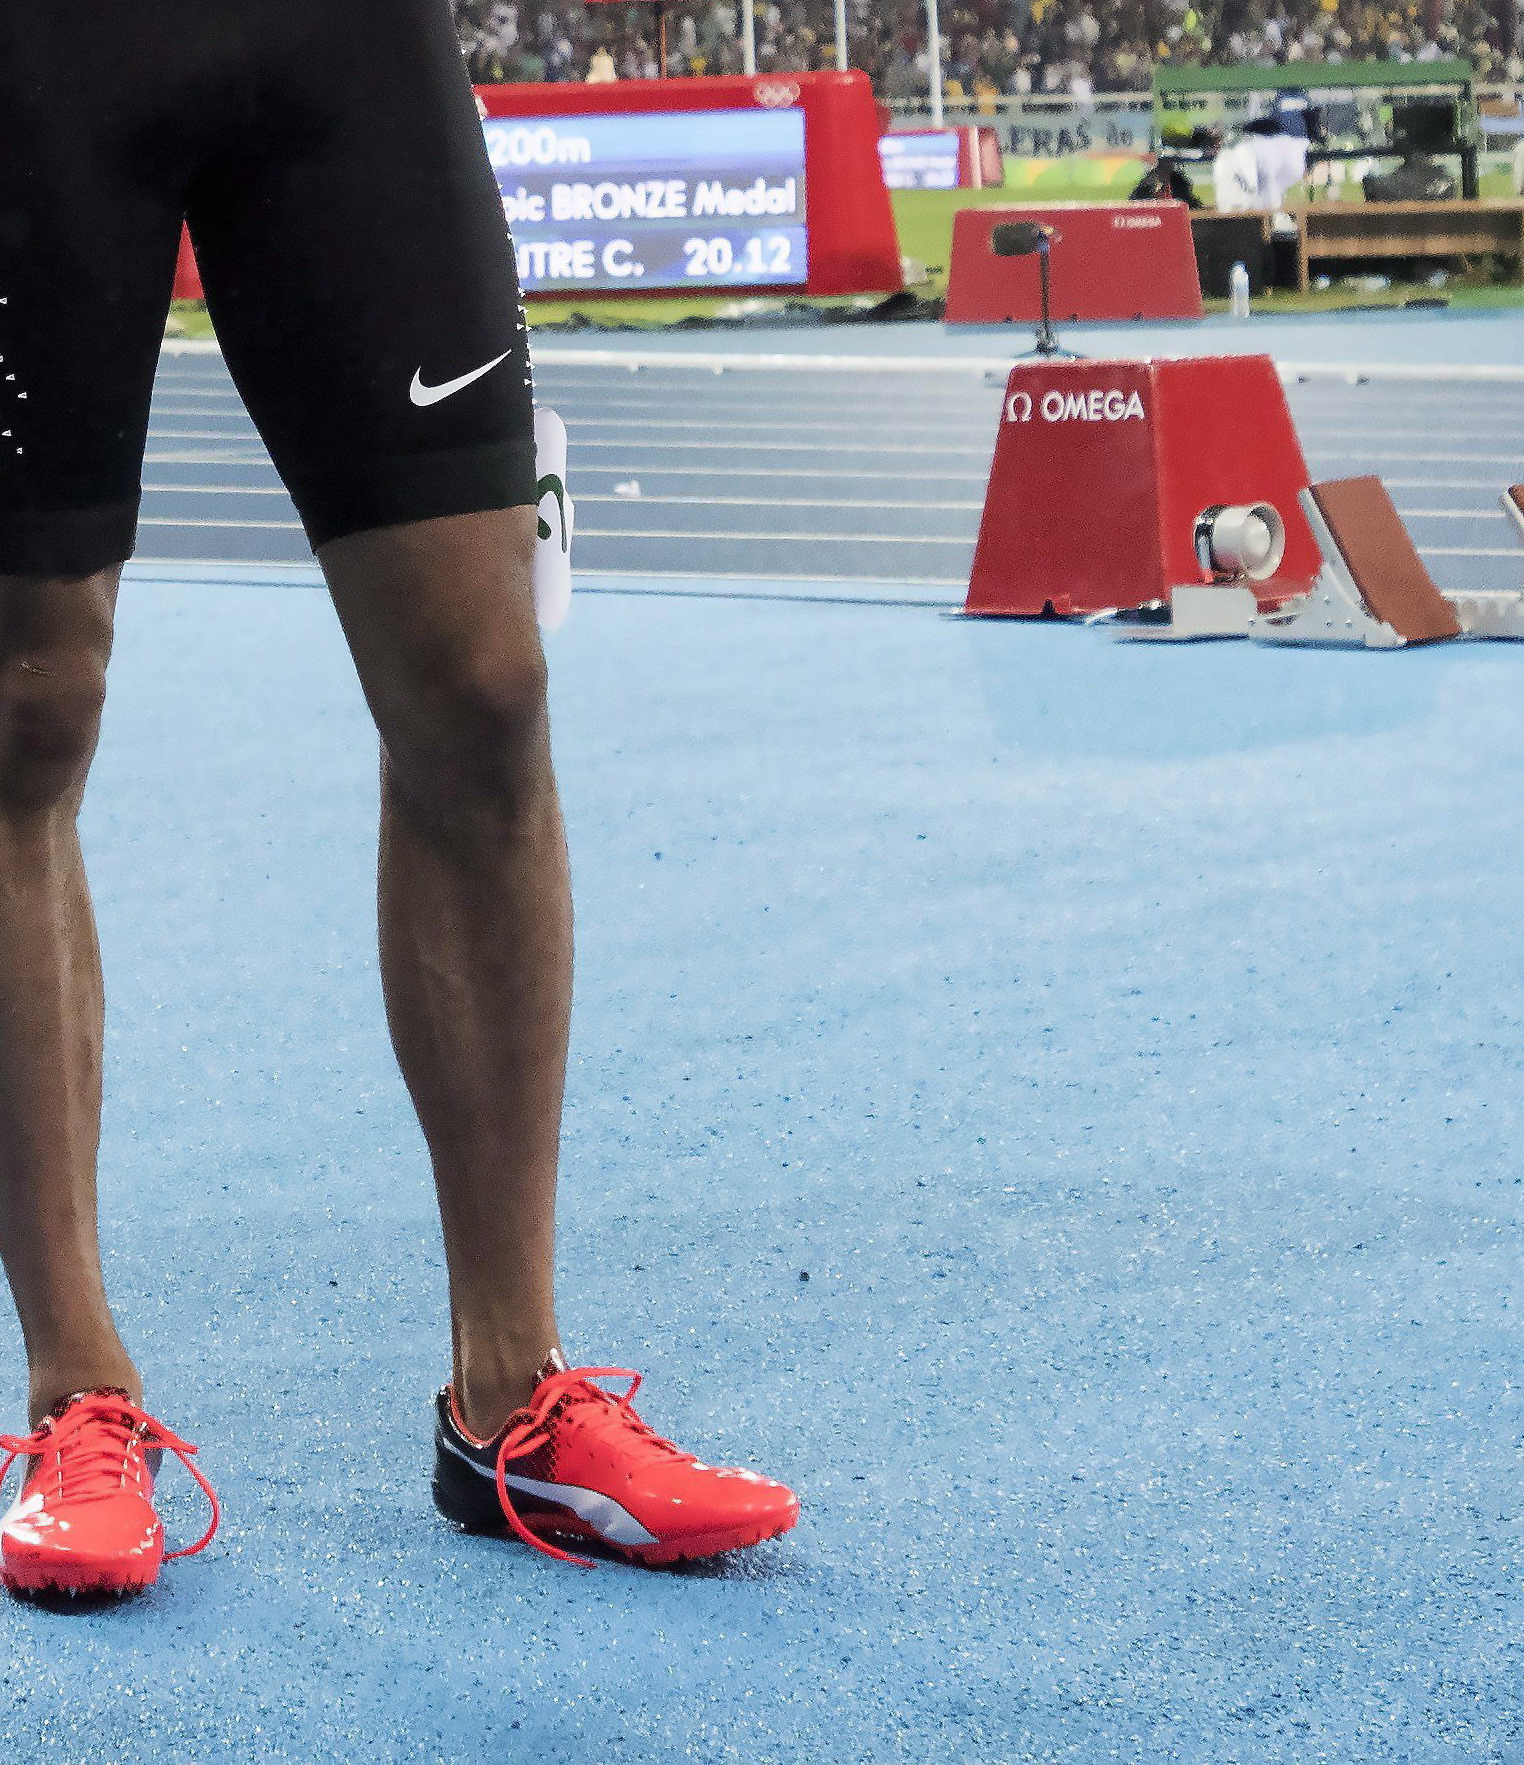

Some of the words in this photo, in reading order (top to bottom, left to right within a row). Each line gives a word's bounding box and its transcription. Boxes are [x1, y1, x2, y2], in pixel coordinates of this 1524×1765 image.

[487, 128, 591, 166] 200m
[551, 180, 687, 220] BRONZE
[693, 176, 796, 216] Medal
[602, 239, 644, 277] C.
[684, 236, 791, 276] 20.12
[1040, 388, 1146, 422] OMEGA
